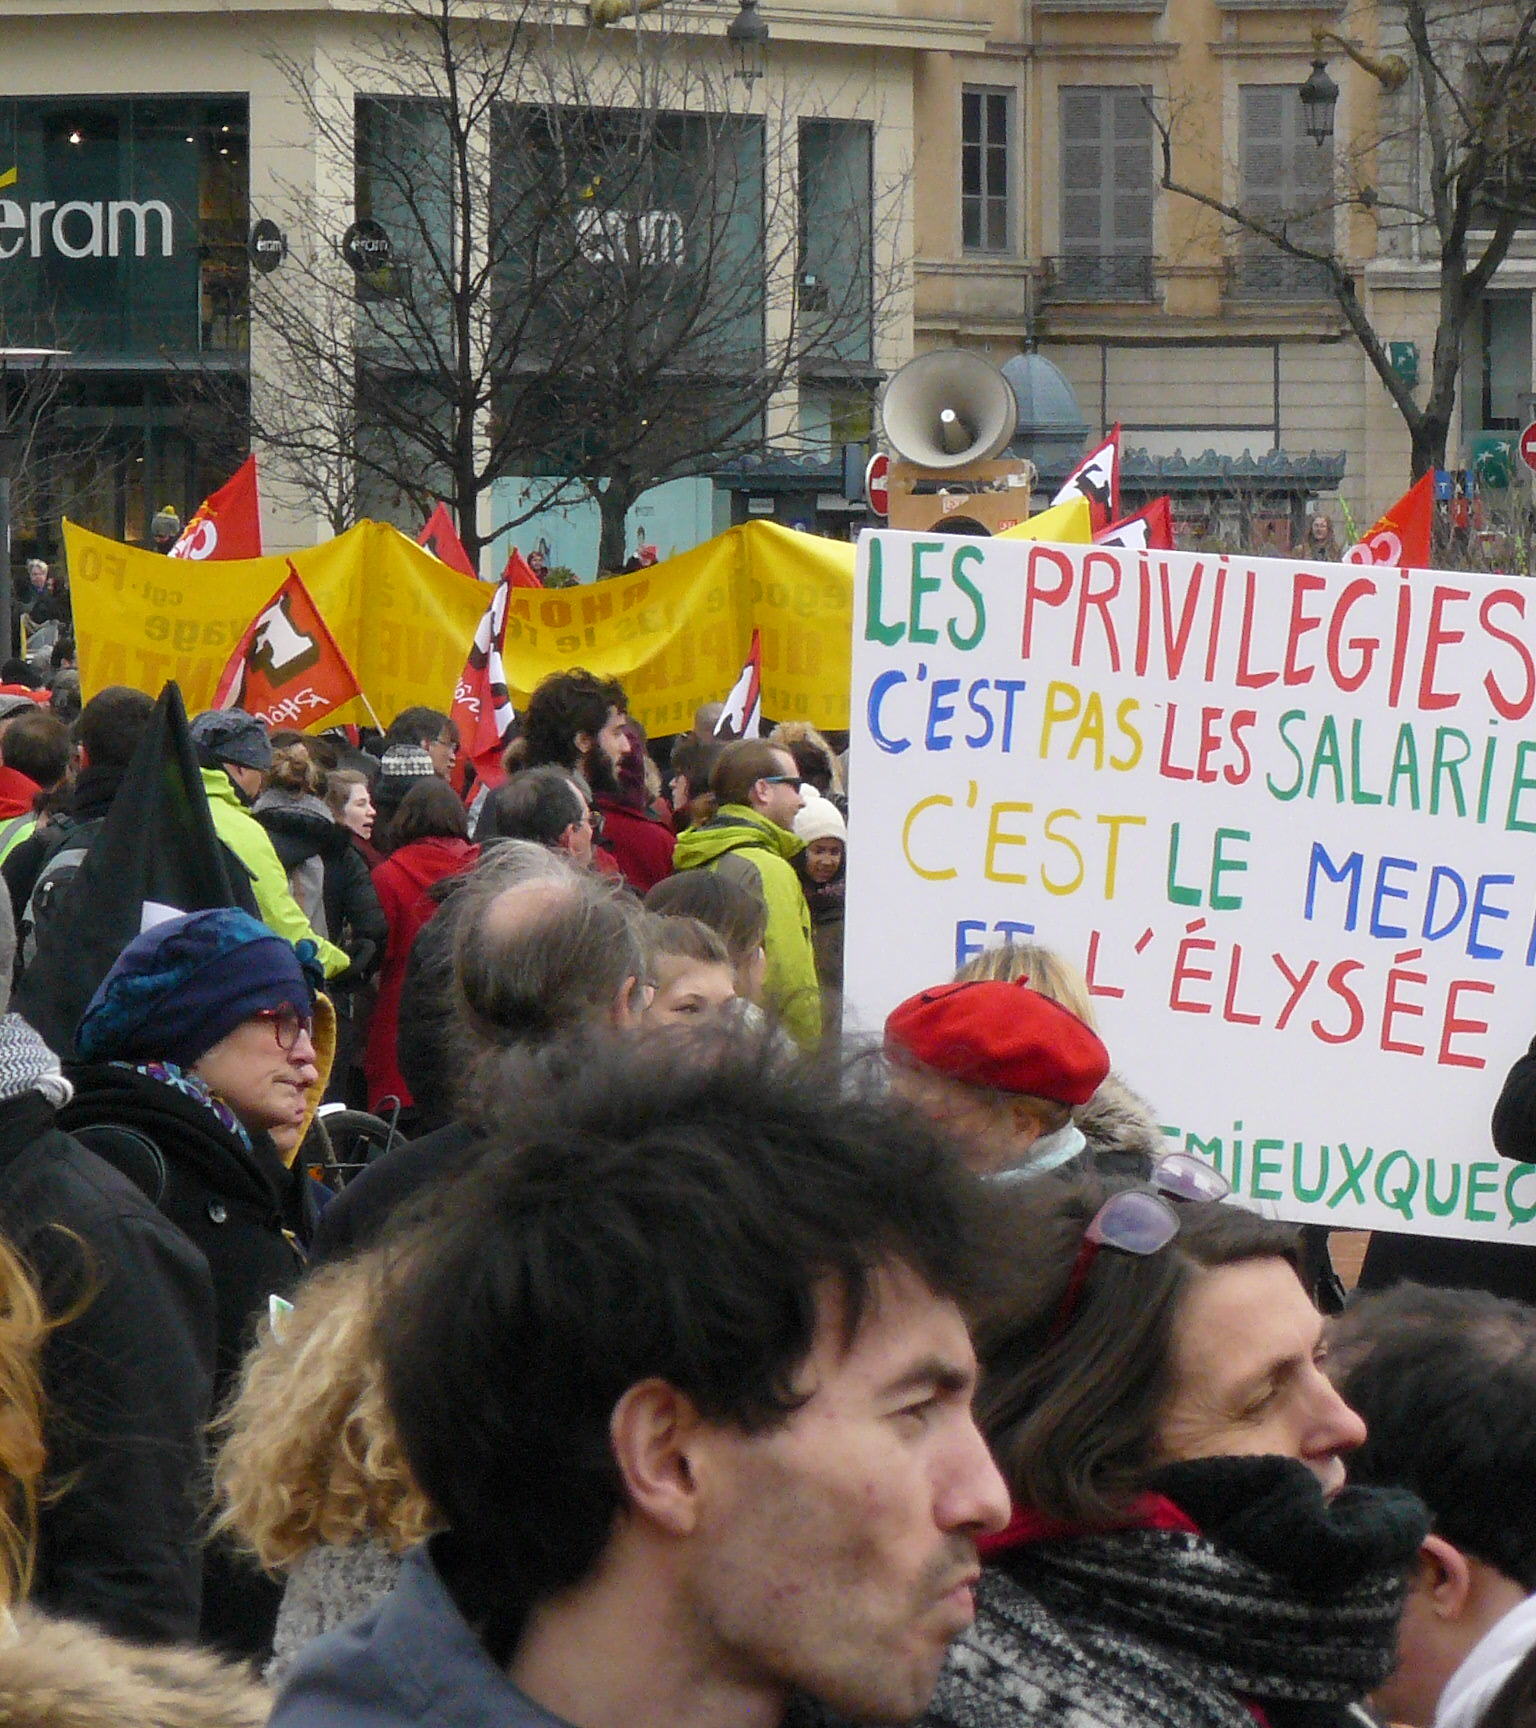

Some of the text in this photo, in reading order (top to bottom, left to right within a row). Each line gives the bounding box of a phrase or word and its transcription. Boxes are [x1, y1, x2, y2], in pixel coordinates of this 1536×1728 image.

[865, 537, 987, 652] LES
[868, 662, 1026, 754] C'EST
[1038, 680, 1144, 771] PAS
[1159, 703, 1257, 786] LES
[902, 780, 1147, 900] C'EST
[1167, 821, 1251, 911] LE
[1086, 917, 1497, 1070] L'ÉLYSÉE
